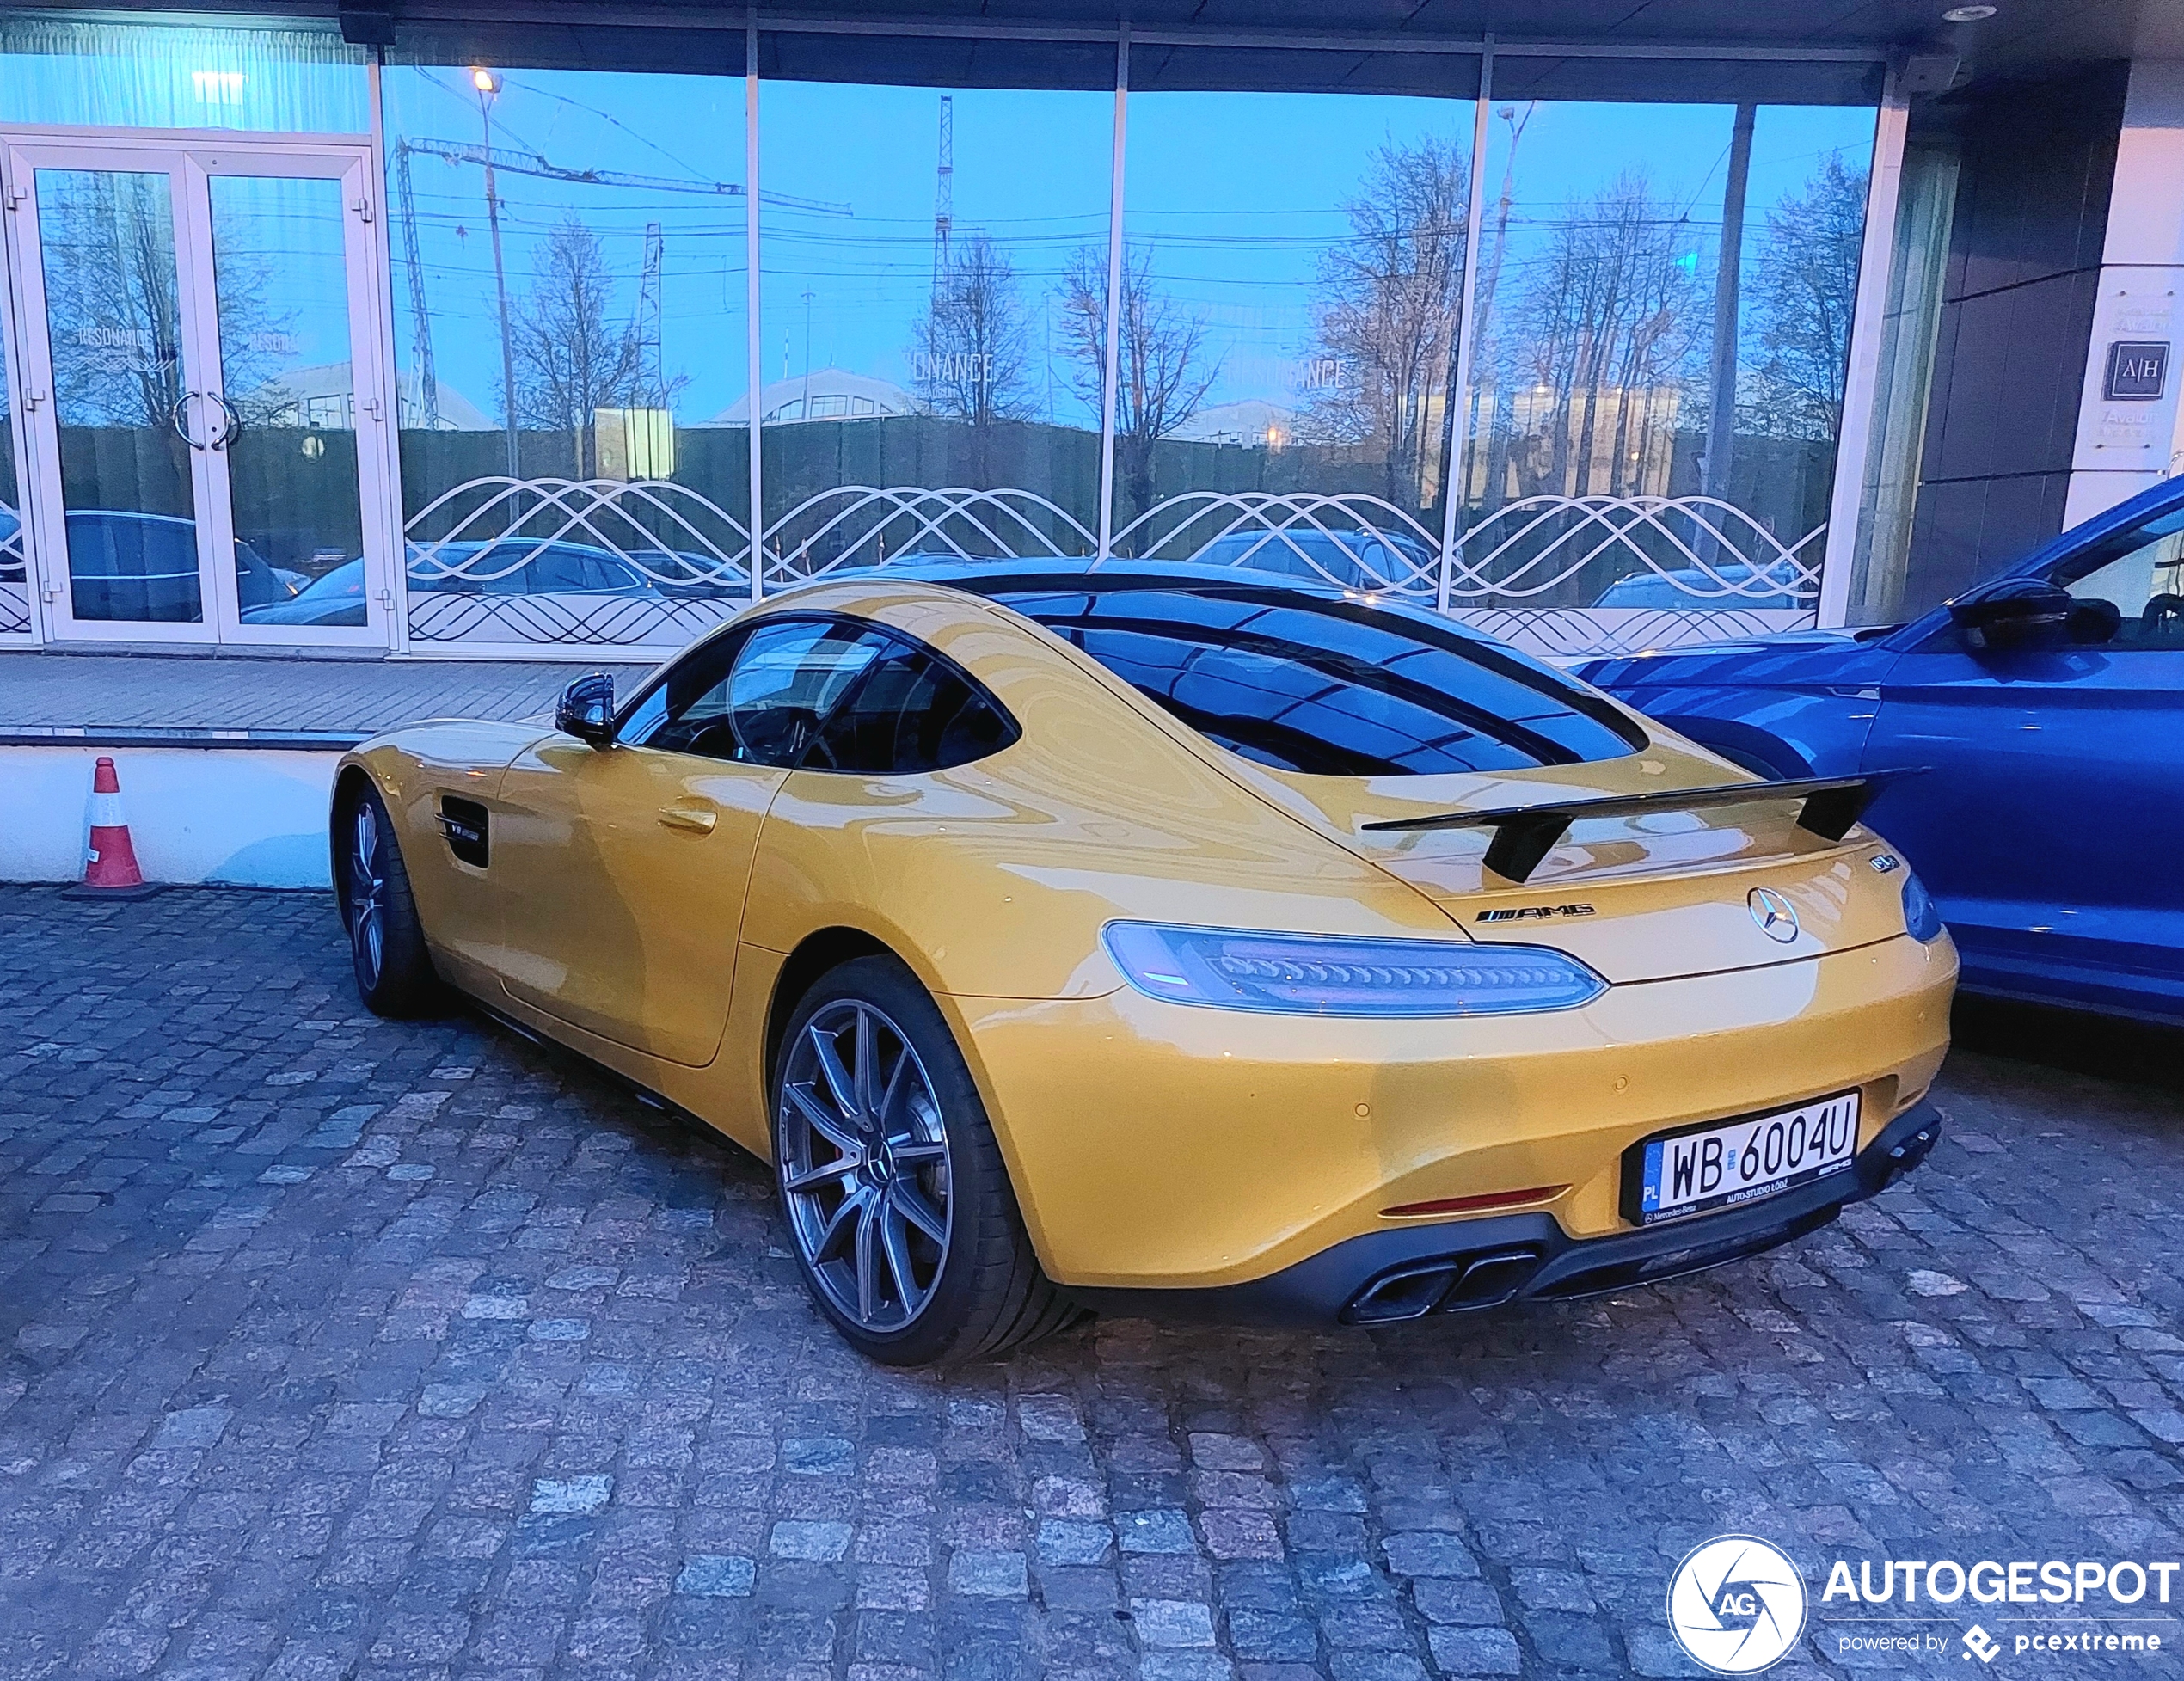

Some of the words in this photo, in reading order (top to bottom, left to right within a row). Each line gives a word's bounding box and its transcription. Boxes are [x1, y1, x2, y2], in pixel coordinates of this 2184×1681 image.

[1512, 903, 1597, 922] AMG
[1673, 1137, 1723, 1200] WB
[1739, 1101, 1851, 1181] 6004U
[1643, 1186, 1659, 1202] PL
[1727, 1185, 1770, 1205] AUTO-STUDIO
[1653, 1205, 1697, 1221] Mercedes-Benz
